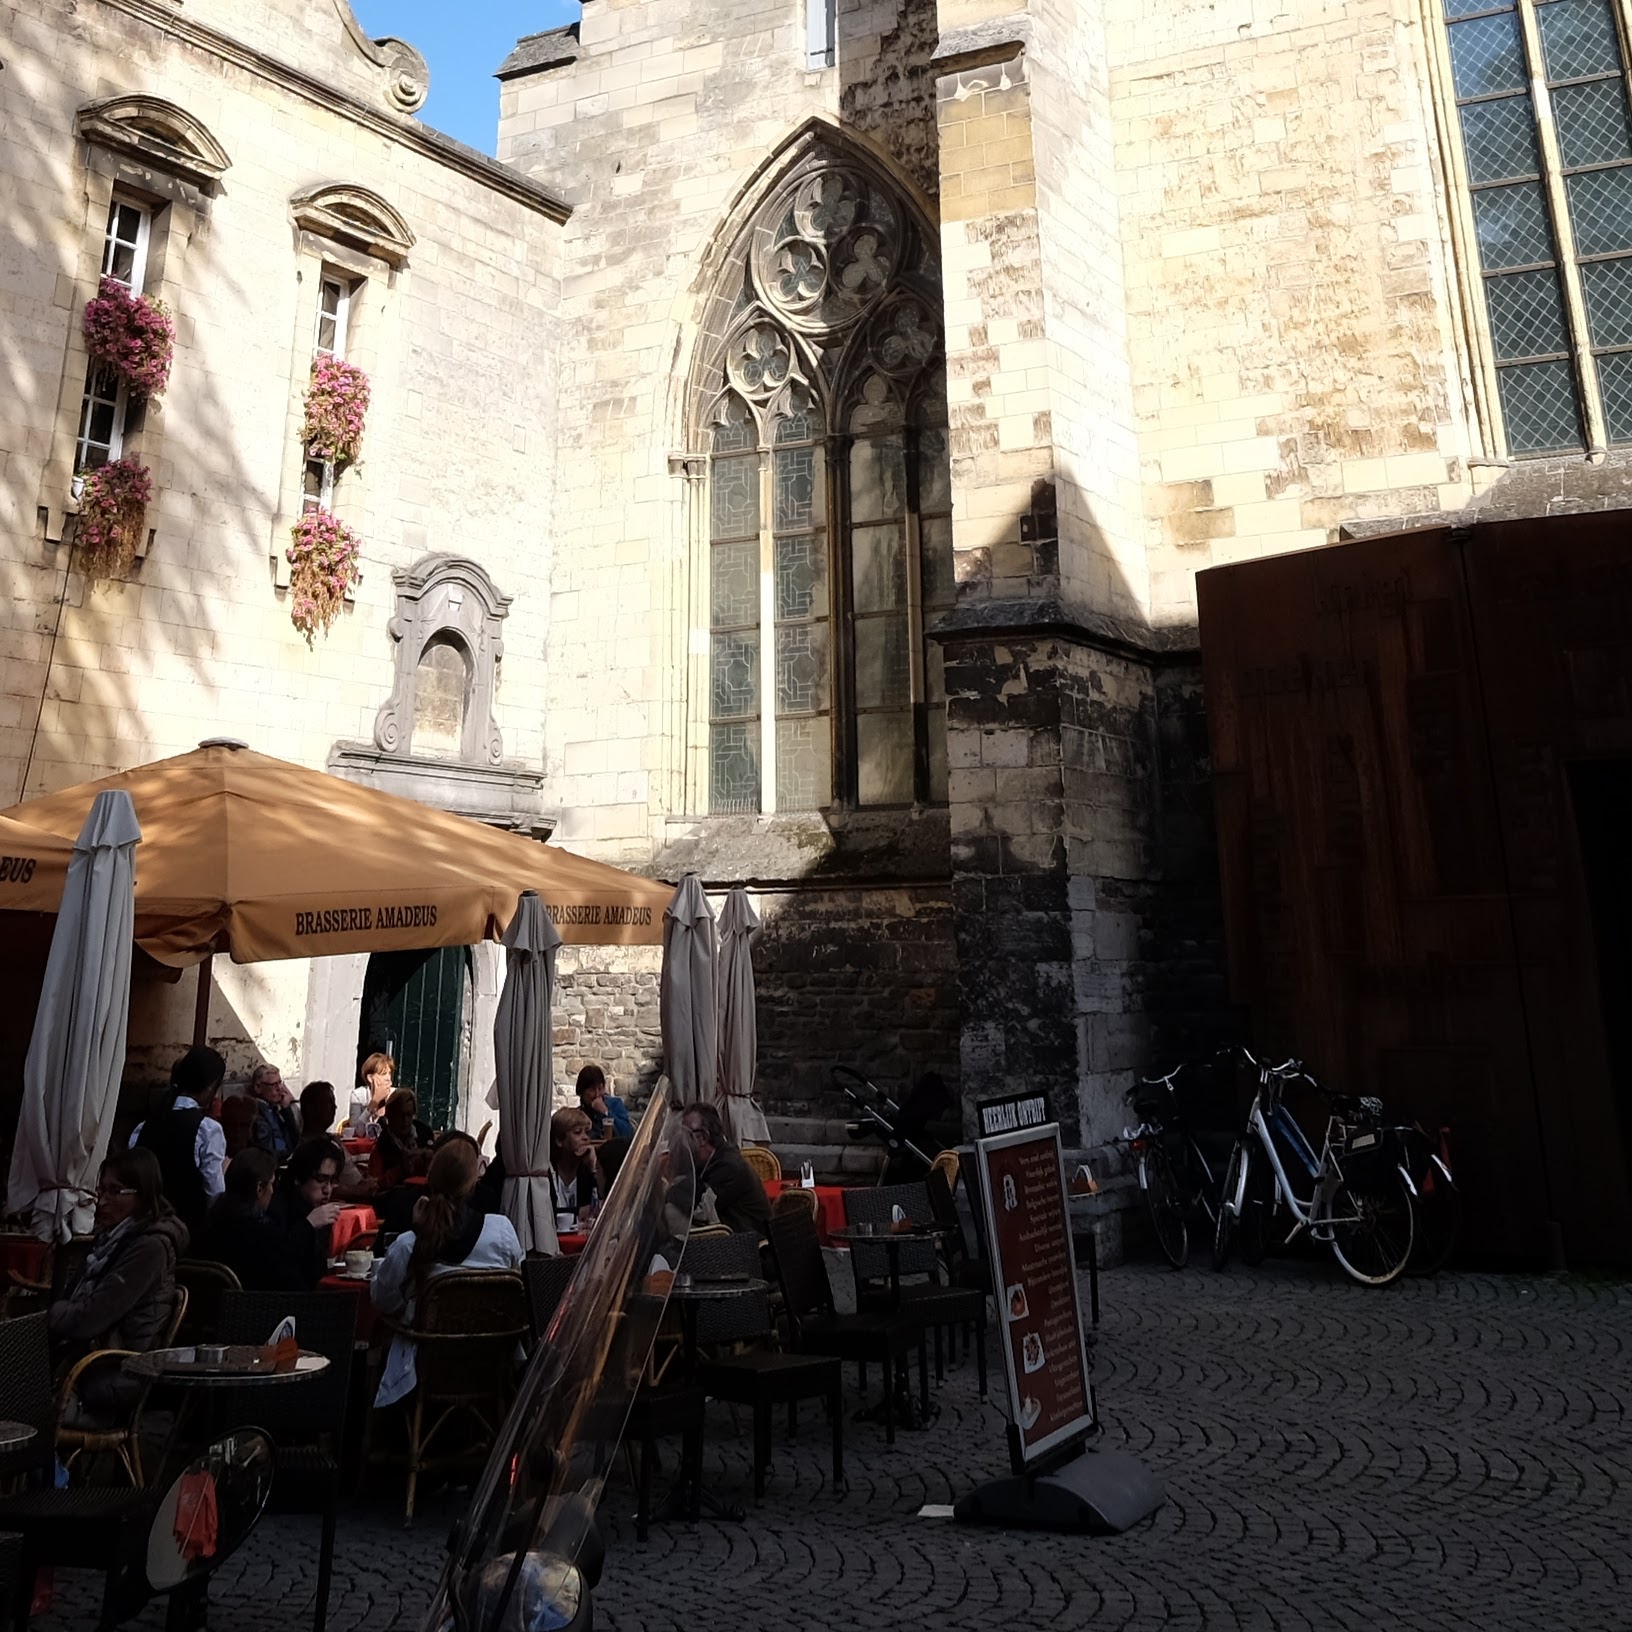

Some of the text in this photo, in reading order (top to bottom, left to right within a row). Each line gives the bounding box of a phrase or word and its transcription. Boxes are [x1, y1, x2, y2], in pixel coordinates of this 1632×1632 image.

[295, 905, 437, 936] BRASSERIE AMADEUS
[603, 906, 652, 926] AMADEUS
